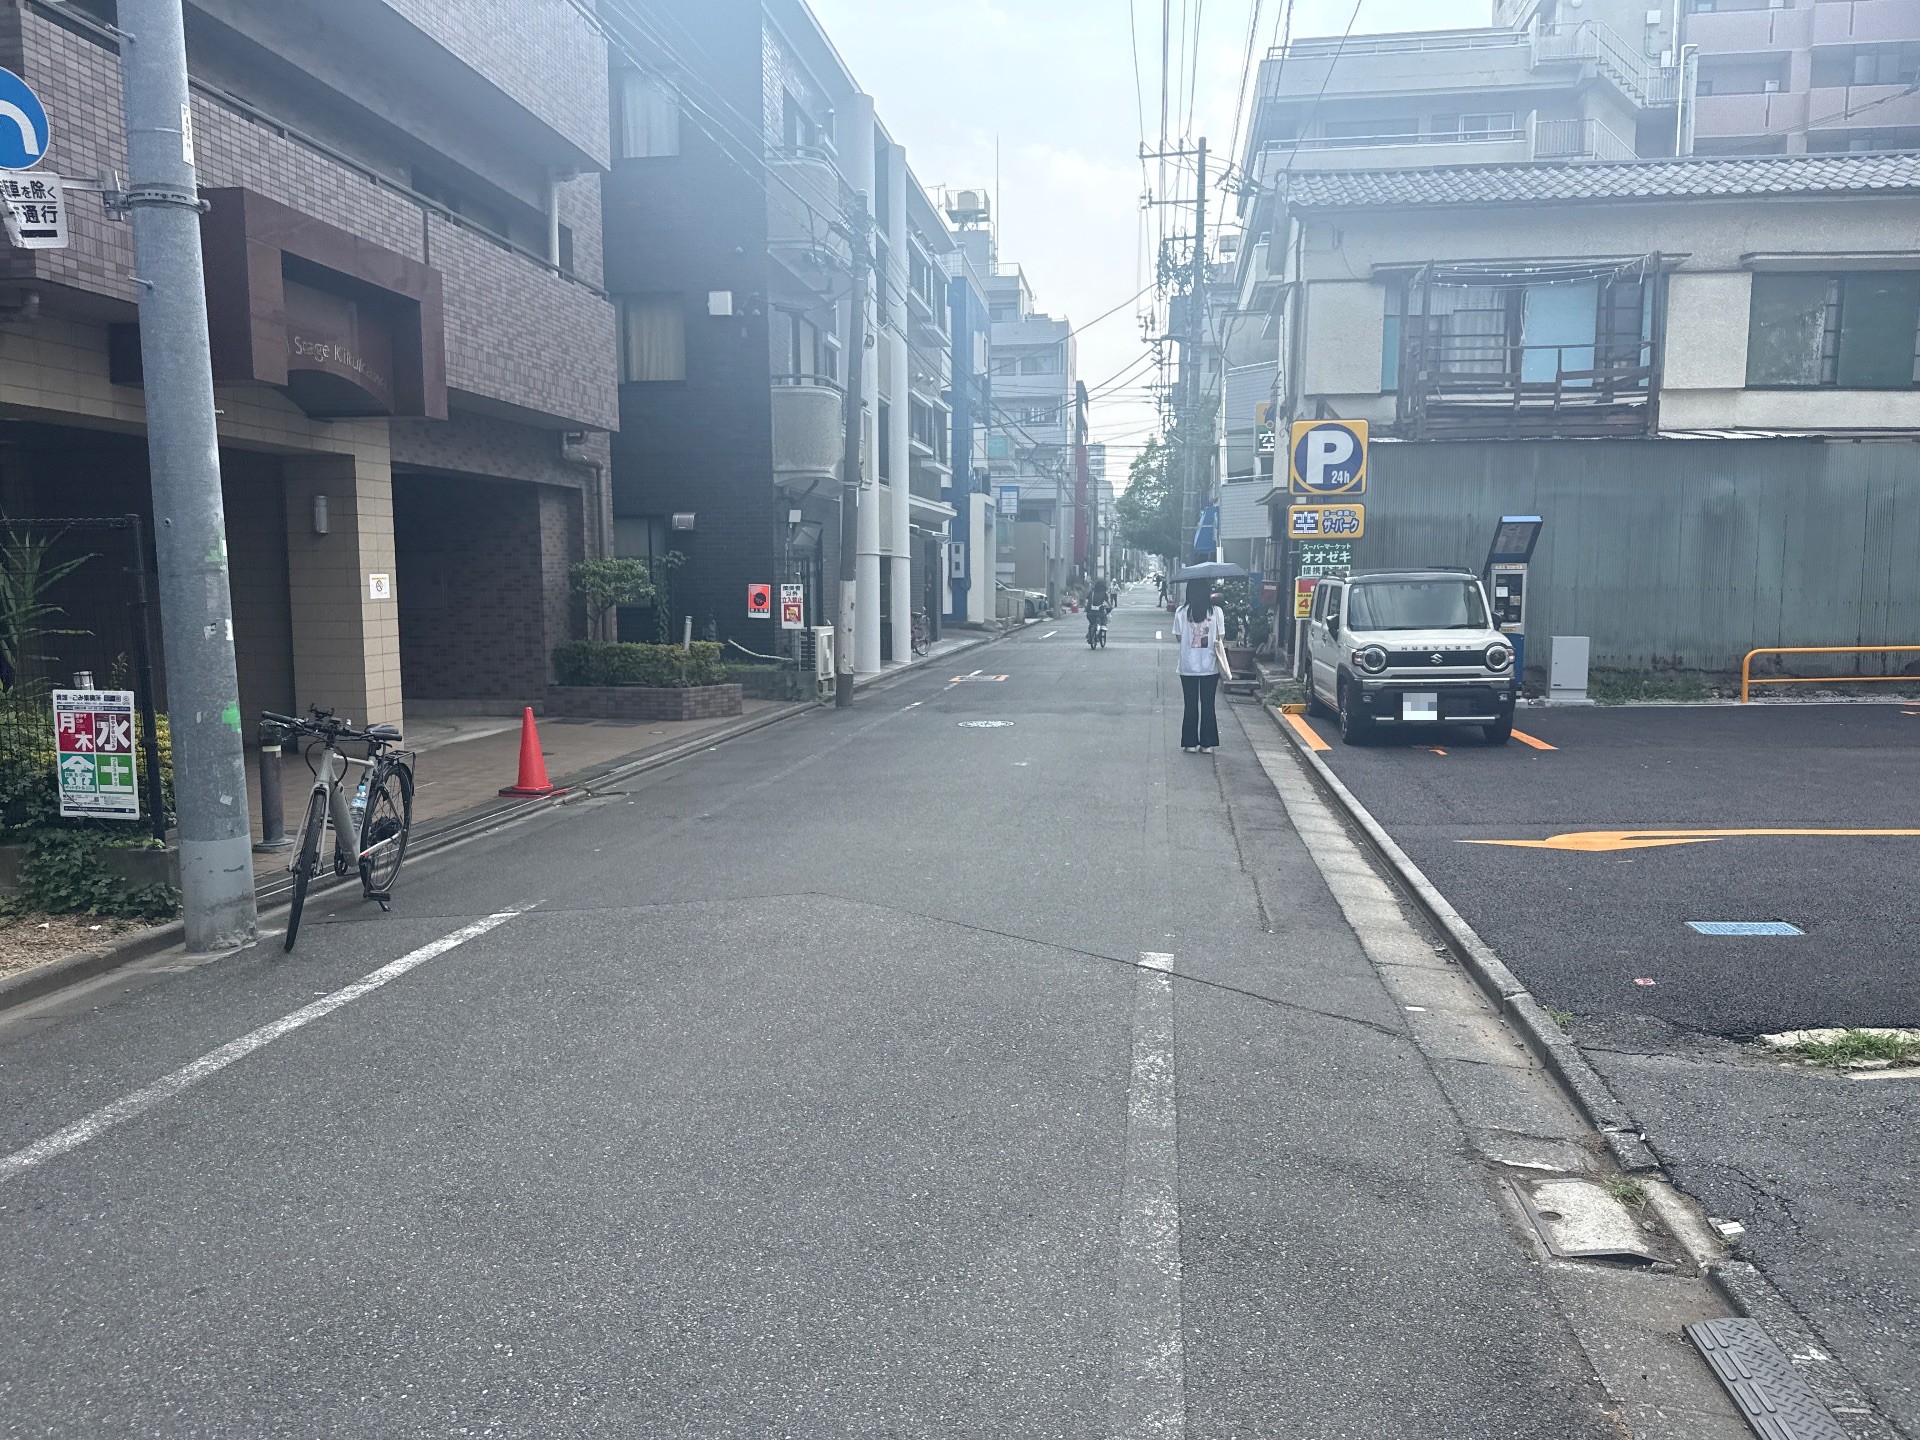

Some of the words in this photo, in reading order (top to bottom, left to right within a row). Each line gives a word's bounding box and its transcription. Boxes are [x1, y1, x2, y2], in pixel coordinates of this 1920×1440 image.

[13, 205, 58, 223] 通行
[294, 336, 330, 362] Stage
[1306, 430, 1354, 484] P
[1331, 470, 1350, 484] 24h
[1293, 511, 1319, 534] 空
[1302, 551, 1352, 563] オオゼキ
[60, 713, 76, 733] 月
[96, 714, 131, 751] 水
[75, 731, 93, 751] 木
[61, 756, 96, 791] 金
[100, 757, 133, 792] 土
